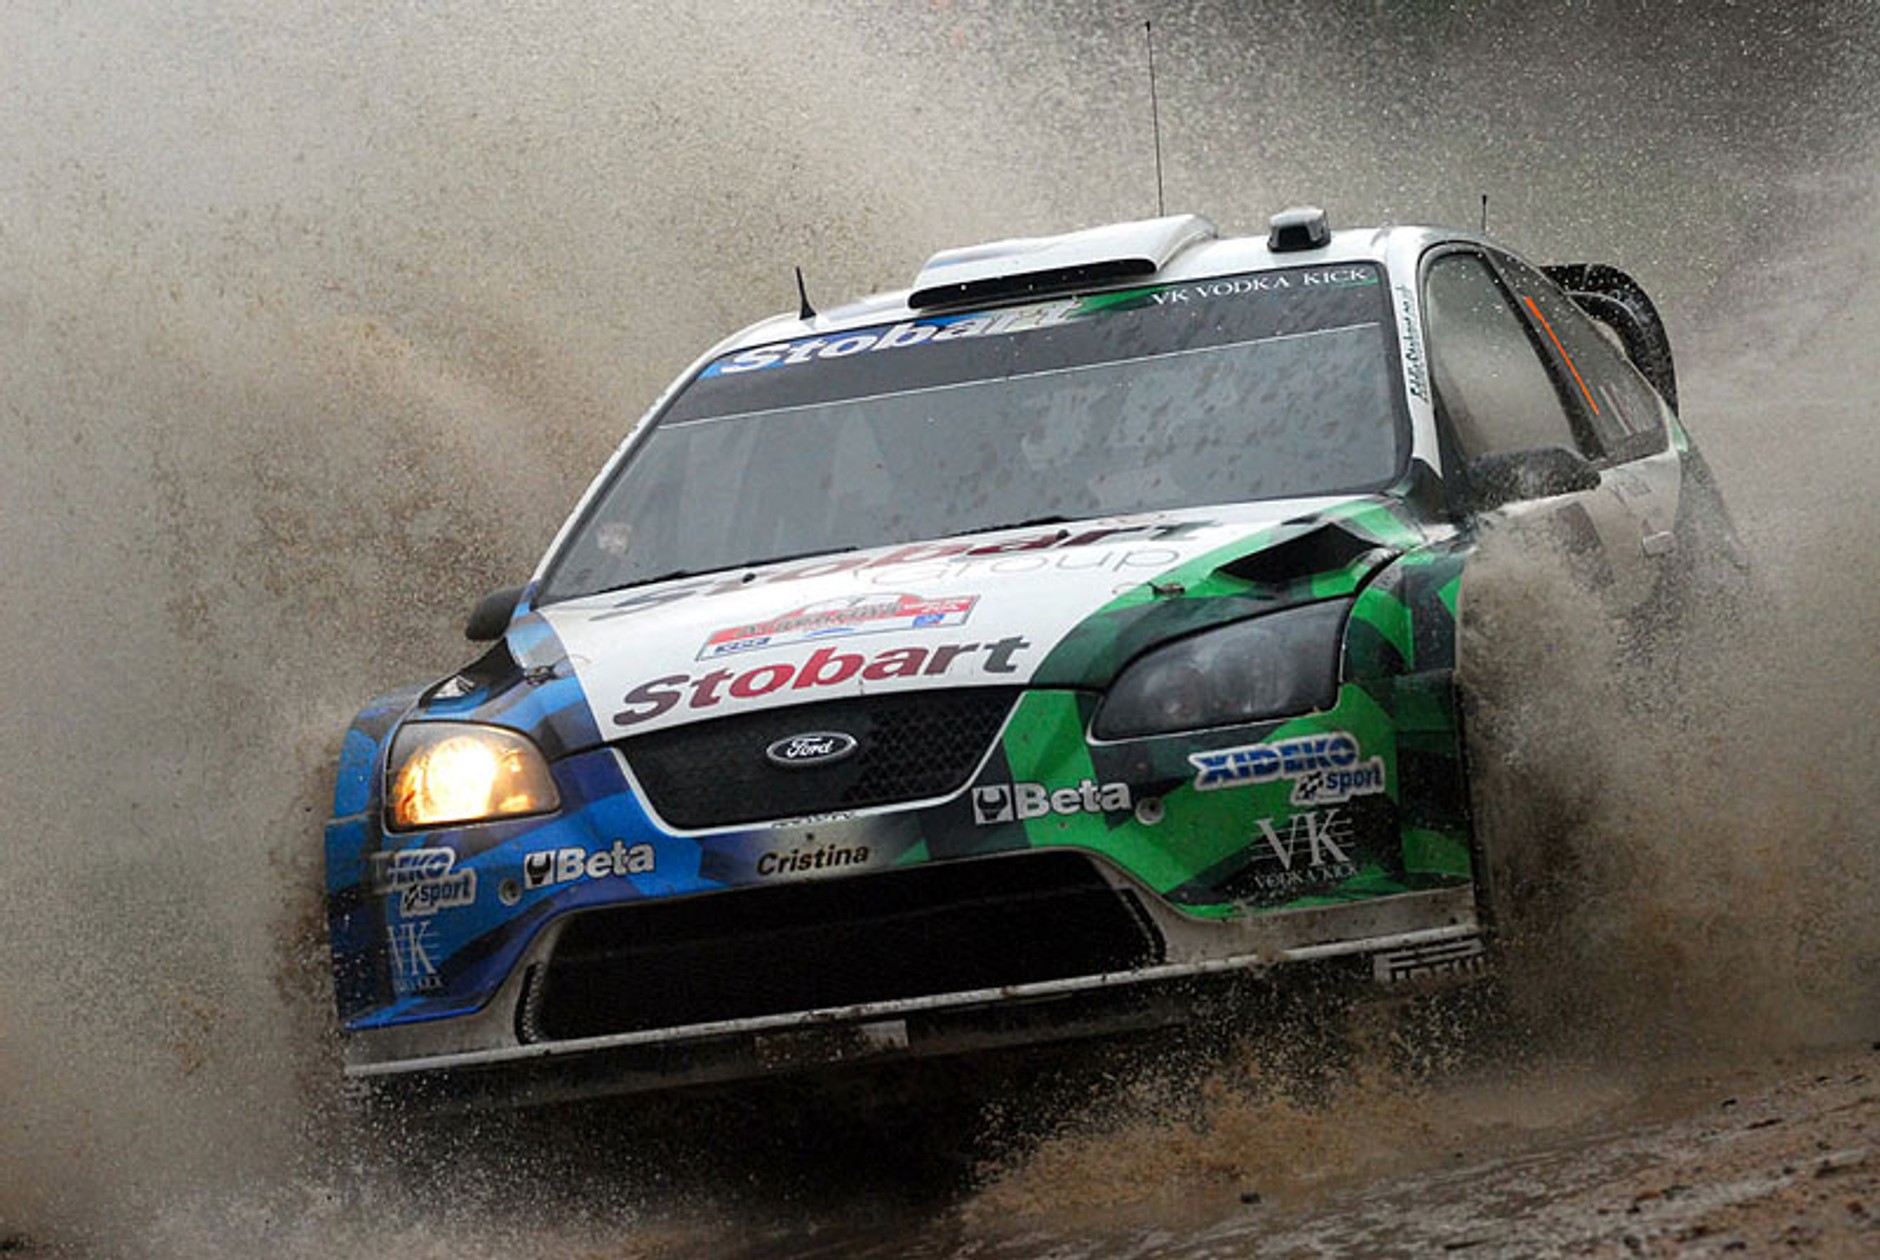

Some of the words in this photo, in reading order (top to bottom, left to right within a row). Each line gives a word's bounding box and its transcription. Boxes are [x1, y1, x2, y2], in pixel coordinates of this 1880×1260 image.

[1152, 288, 1189, 305] VK
[1195, 277, 1290, 299] VODKA
[1302, 268, 1368, 286] KICK
[719, 298, 1081, 373] Stobart
[612, 634, 1031, 727] Stobart
[786, 736, 835, 758] Ford
[1200, 736, 1358, 786] XIDEKO
[1014, 778, 1132, 821] Beta
[1325, 764, 1382, 795] sport
[757, 843, 870, 876] Cristina
[1254, 808, 1351, 870] VK
[555, 839, 656, 883] Beta
[420, 876, 471, 905] sport
